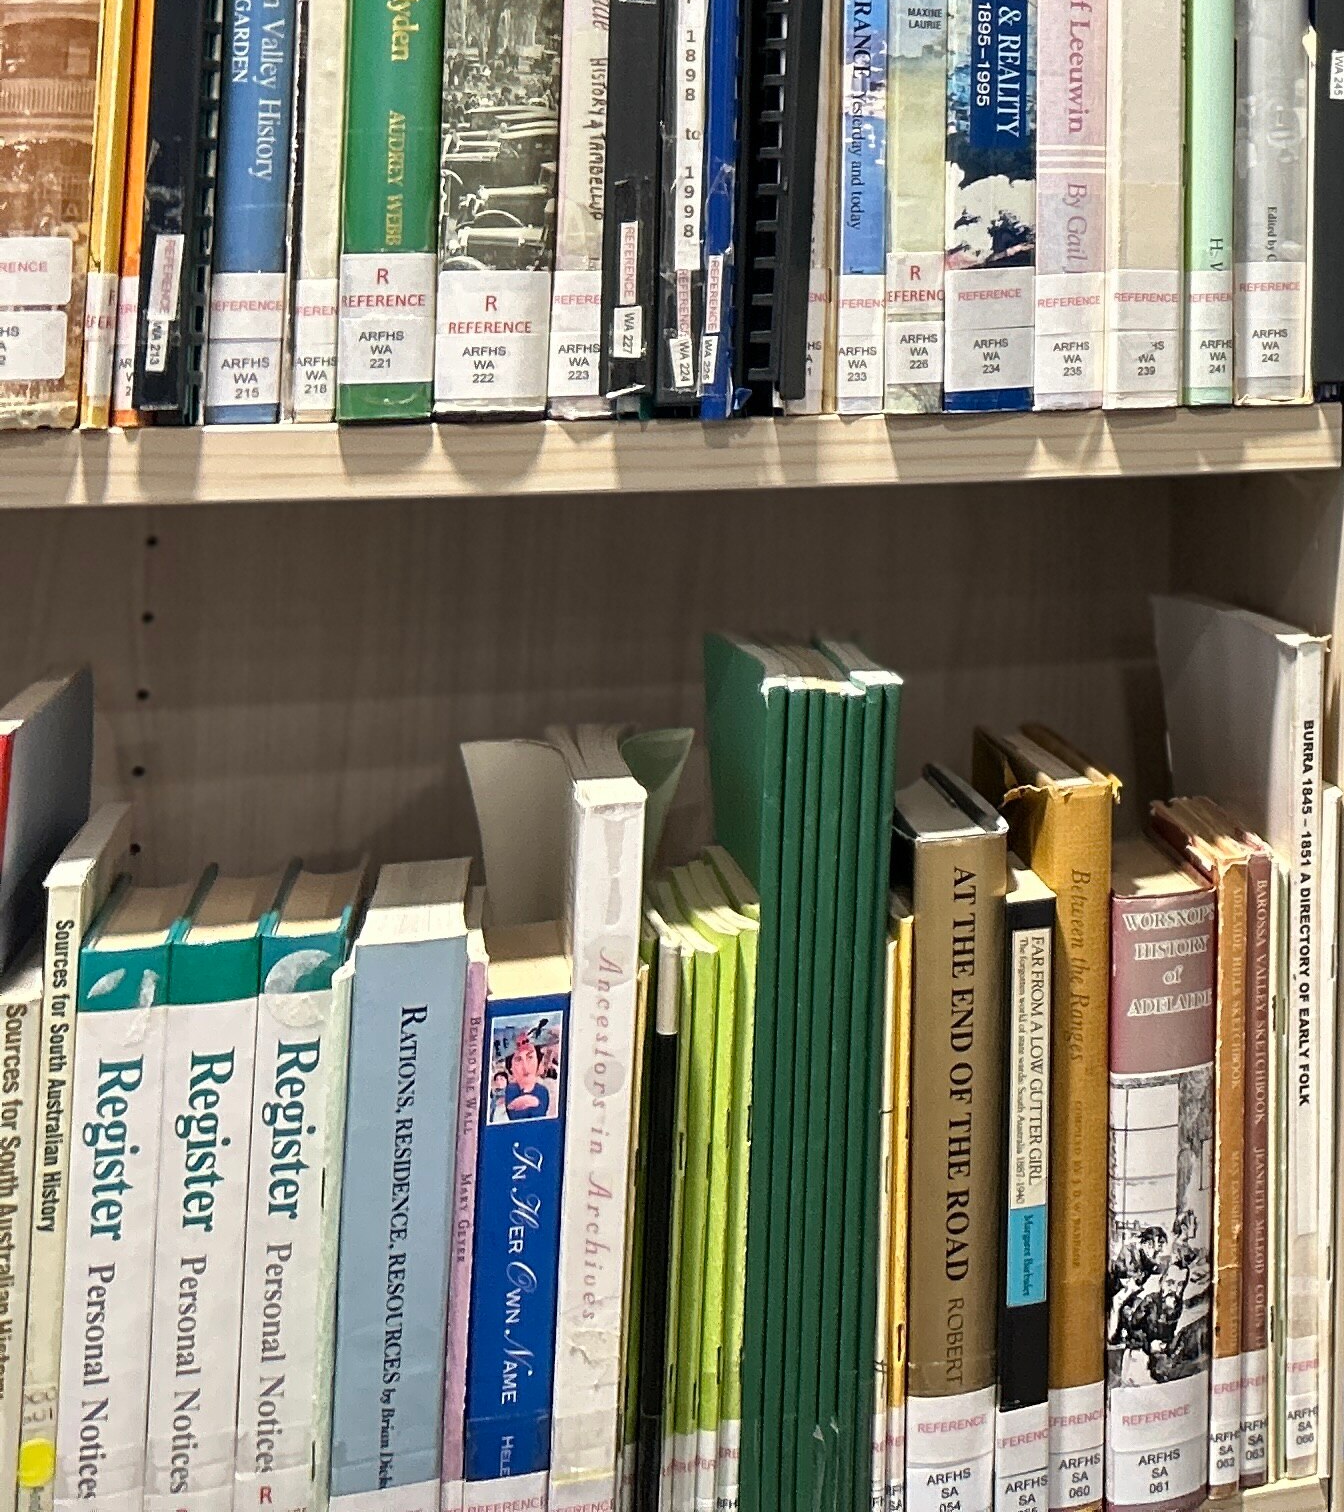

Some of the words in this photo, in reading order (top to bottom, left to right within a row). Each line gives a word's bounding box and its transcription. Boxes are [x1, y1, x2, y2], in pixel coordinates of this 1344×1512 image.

[998, 7, 1022, 29] &
[253, 19, 284, 89] Valley
[1067, 19, 1091, 133] Leeuwin
[996, 33, 1023, 138] REALITY
[247, 99, 281, 182] History
[388, 110, 405, 185] AUDREY
[385, 194, 403, 245] WEBB
[341, 293, 426, 308] REFERENCE
[377, 267, 390, 285] R
[359, 330, 405, 342] ARFHS
[369, 357, 392, 369] 221
[370, 343, 393, 356] WA
[1303, 719, 1314, 775] BURRA
[1302, 779, 1313, 815] 1845
[1301, 831, 1311, 865] 1851
[1301, 872, 1311, 883] A
[953, 867, 976, 911] AT
[52, 919, 74, 998] Sources
[953, 916, 976, 978] THE
[1299, 887, 1311, 978] DIRECTORY
[52, 999, 72, 1023] for
[950, 988, 975, 1054] END
[1299, 982, 1310, 1003] OF
[48, 1024, 70, 1074] South
[1298, 1005, 1310, 1060] EARLY
[948, 1062, 974, 1110] OF
[1297, 1065, 1310, 1106] FOLK
[41, 1078, 68, 1165] Australian
[82, 1054, 144, 1241] Register
[174, 1046, 235, 1233] Register
[262, 1036, 320, 1219] Register
[946, 1114, 972, 1180] THE
[36, 1170, 62, 1233] History
[944, 1190, 971, 1283] ROAD
[83, 1261, 116, 1386] Personal
[175, 1255, 207, 1377] Personal
[260, 1242, 293, 1364] Personal
[77, 1400, 109, 1500] Notices
[170, 1391, 202, 1495] Notices
[255, 1378, 285, 1474] Notices
[1138, 1448, 1181, 1466] ARFHS
[1151, 1466, 1169, 1480] SA
